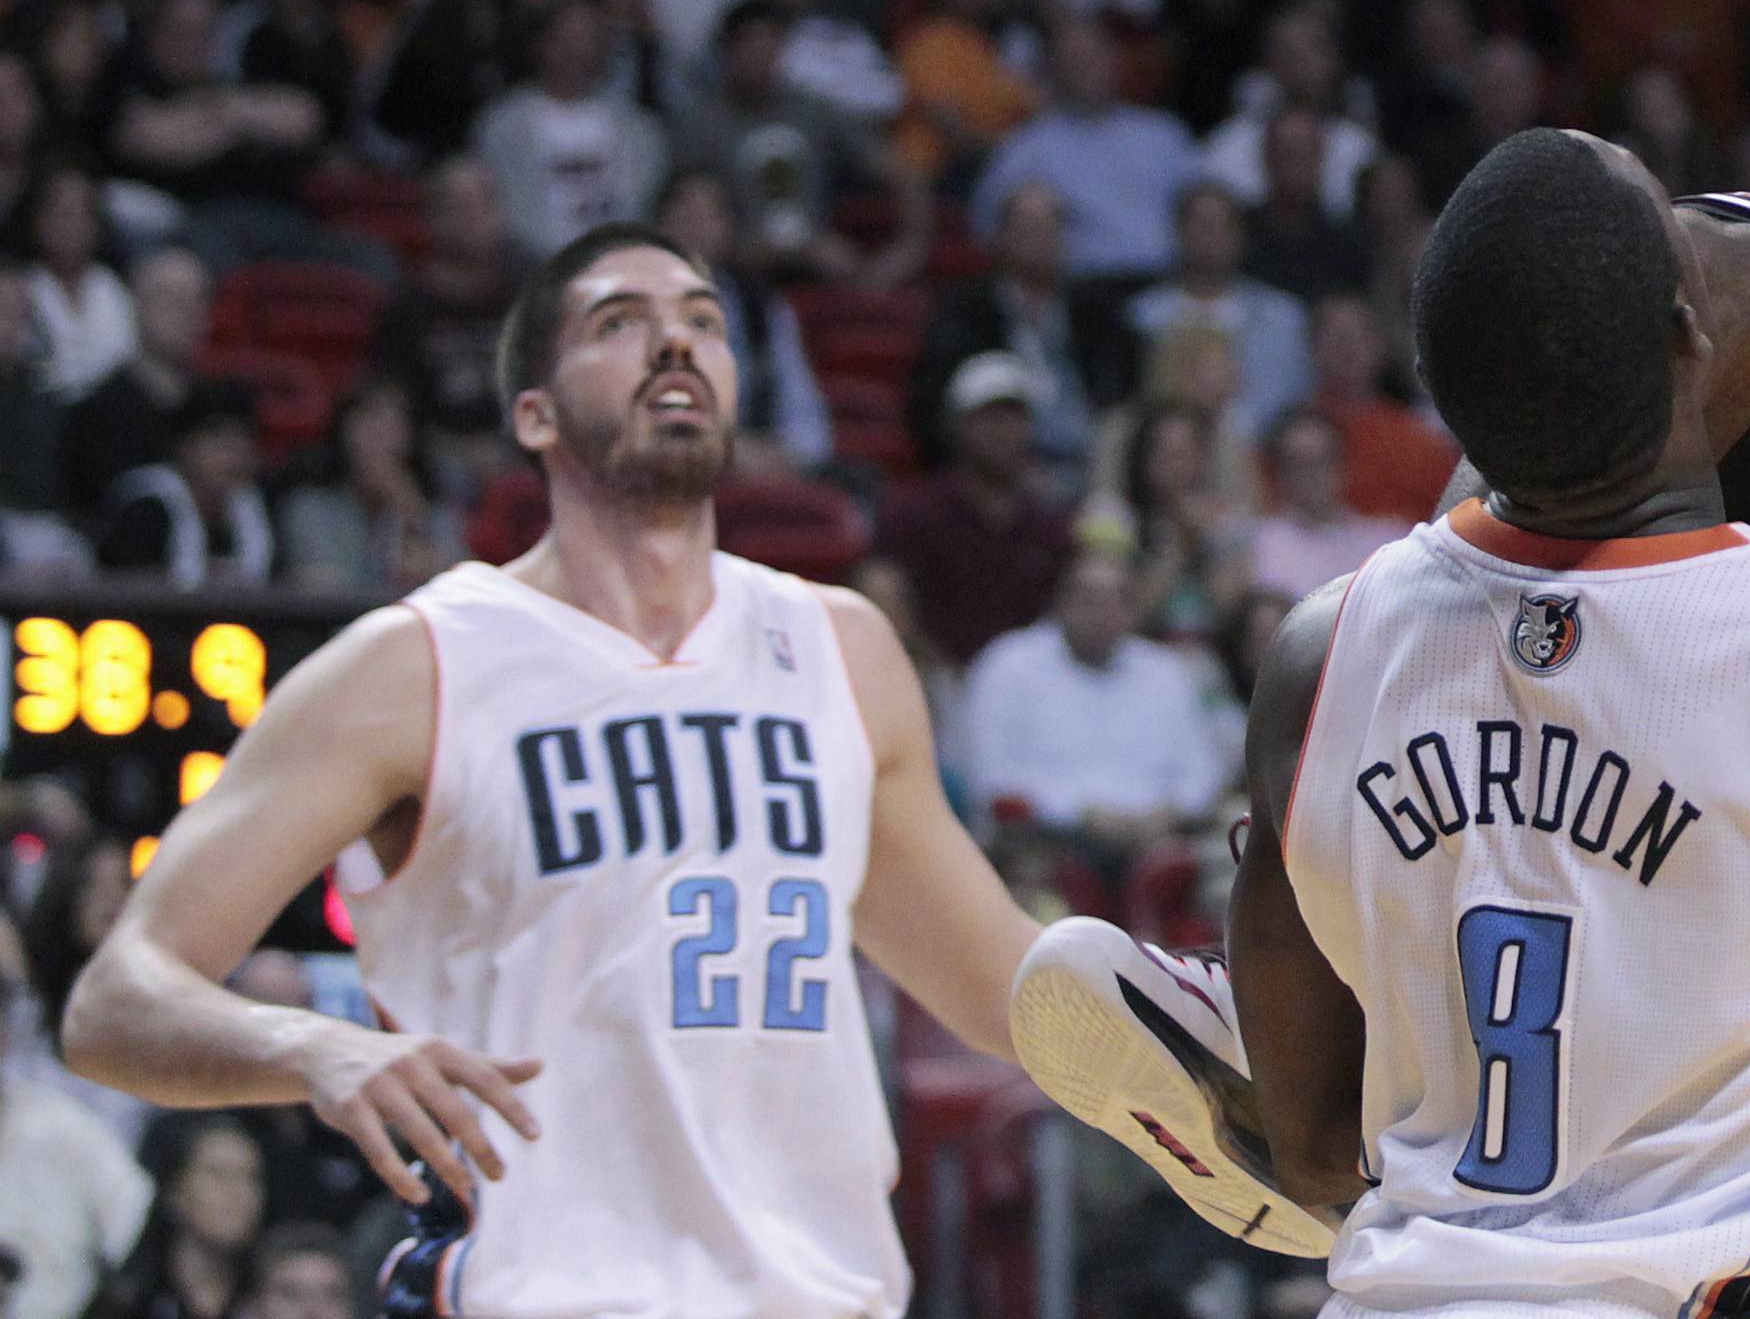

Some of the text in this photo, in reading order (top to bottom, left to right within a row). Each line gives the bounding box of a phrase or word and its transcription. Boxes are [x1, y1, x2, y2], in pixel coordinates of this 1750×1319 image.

[517, 713, 824, 875] CATS
[1357, 720, 1702, 887] GORDON
[669, 878, 829, 1031] 22
[1453, 904, 1575, 1196] 8
